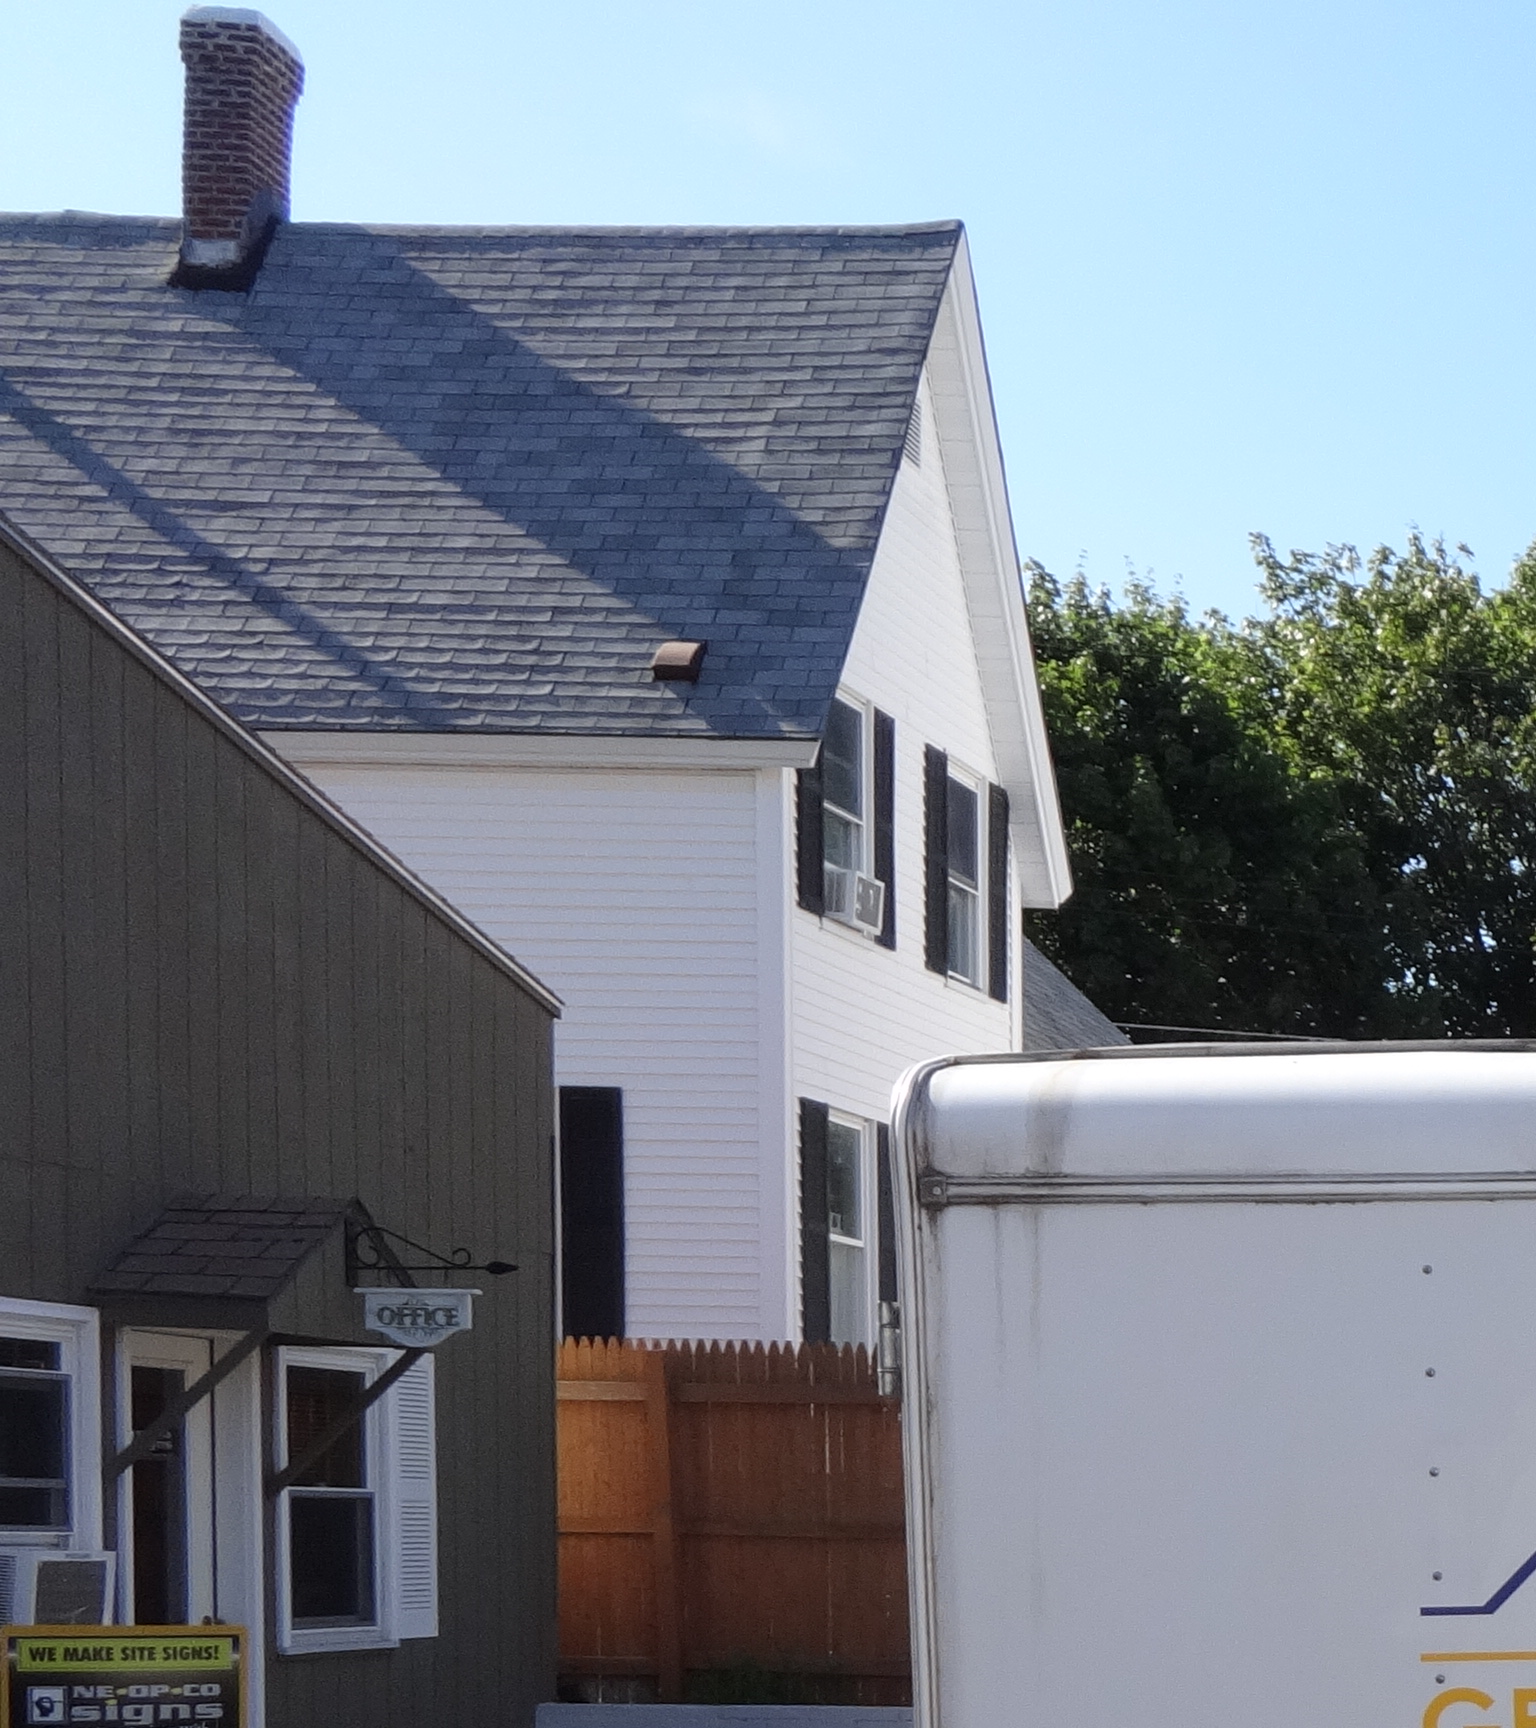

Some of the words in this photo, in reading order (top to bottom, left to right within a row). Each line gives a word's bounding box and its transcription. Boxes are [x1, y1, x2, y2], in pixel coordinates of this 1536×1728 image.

[377, 1306, 460, 1326] OFFICE
[29, 1647, 57, 1662] WE
[63, 1646, 114, 1662] MAKE
[121, 1646, 158, 1661] SITE
[163, 1645, 219, 1661] SIGNS!
[70, 1699, 224, 1725] signs
